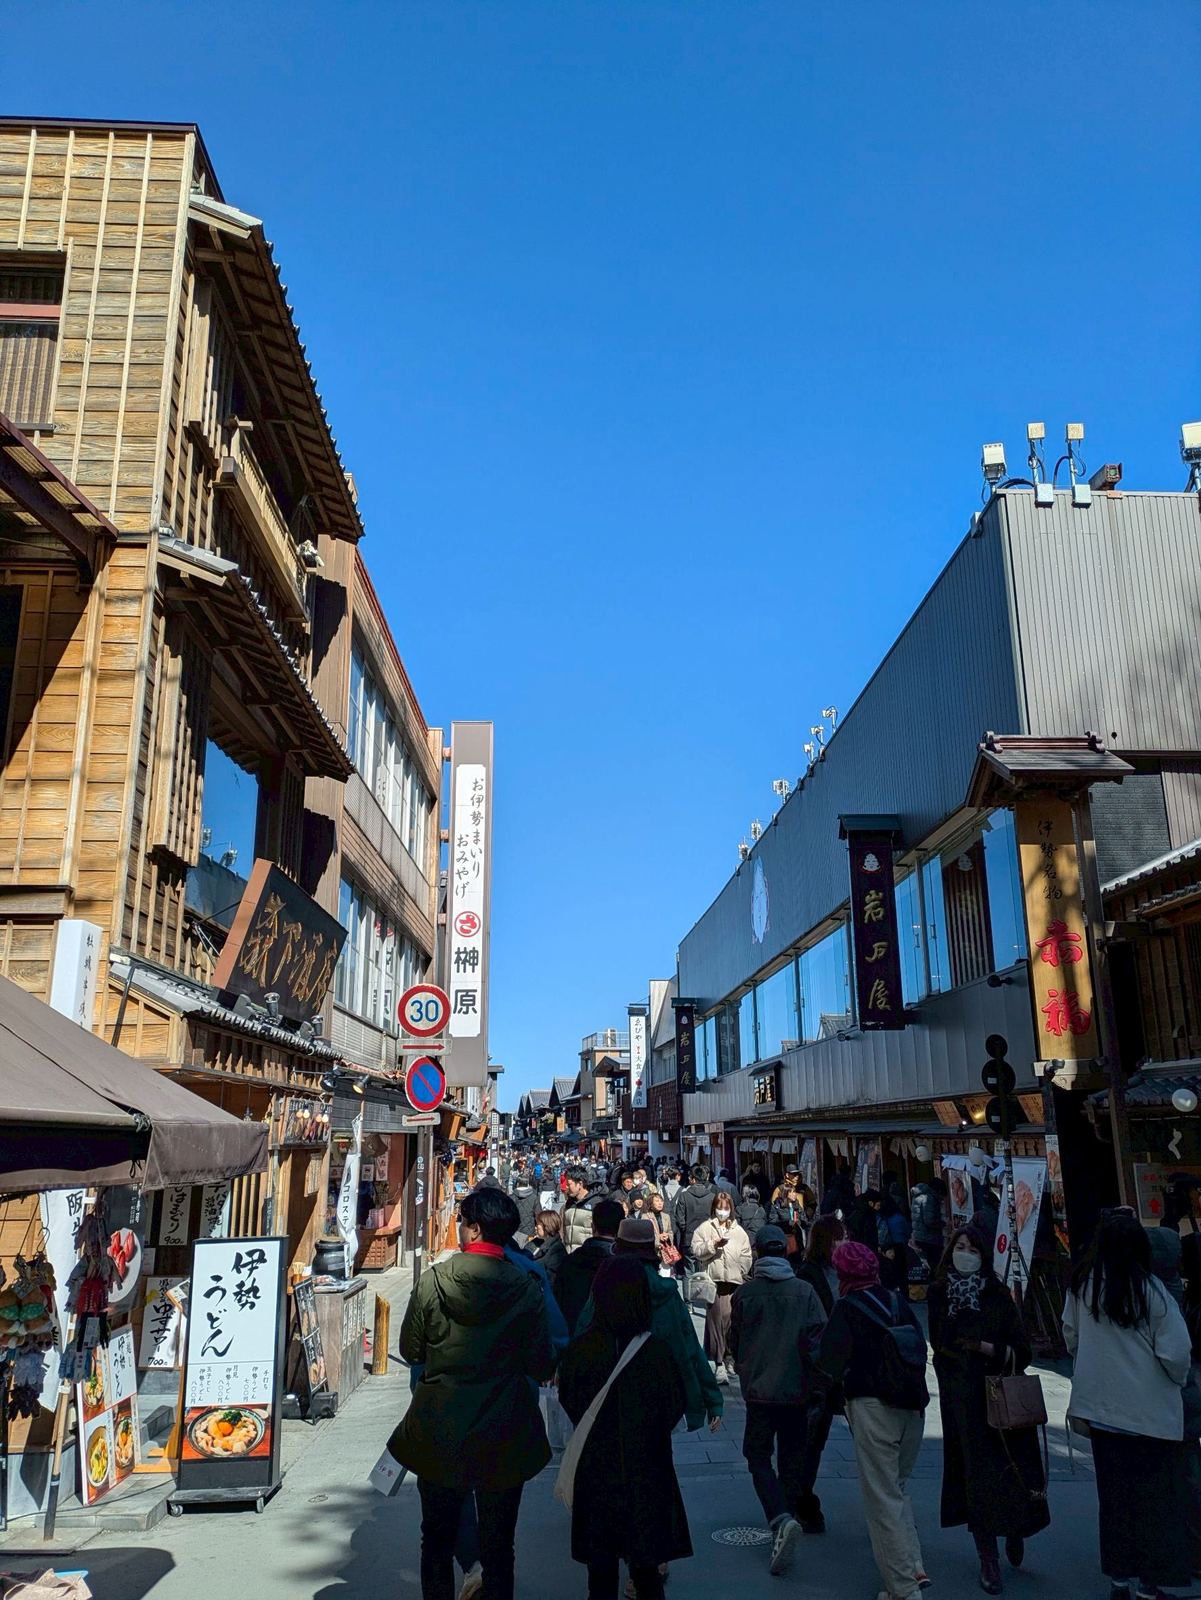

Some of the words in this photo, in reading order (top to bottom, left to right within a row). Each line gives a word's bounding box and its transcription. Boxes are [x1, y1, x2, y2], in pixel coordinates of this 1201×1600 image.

[470, 777, 484, 879] お伊勢まいり
[1036, 820, 1063, 899] 伊勢名物
[455, 833, 470, 900] おみやげ
[453, 946, 479, 1016] 榊原
[863, 889, 892, 1011] 岩戸屋
[1035, 919, 1092, 1037] 赤福
[409, 1000, 439, 1023] 30
[201, 1274, 235, 1357] うどん
[231, 1248, 267, 1312] 伊勢
[150, 1303, 176, 1353] ゆずサワー
